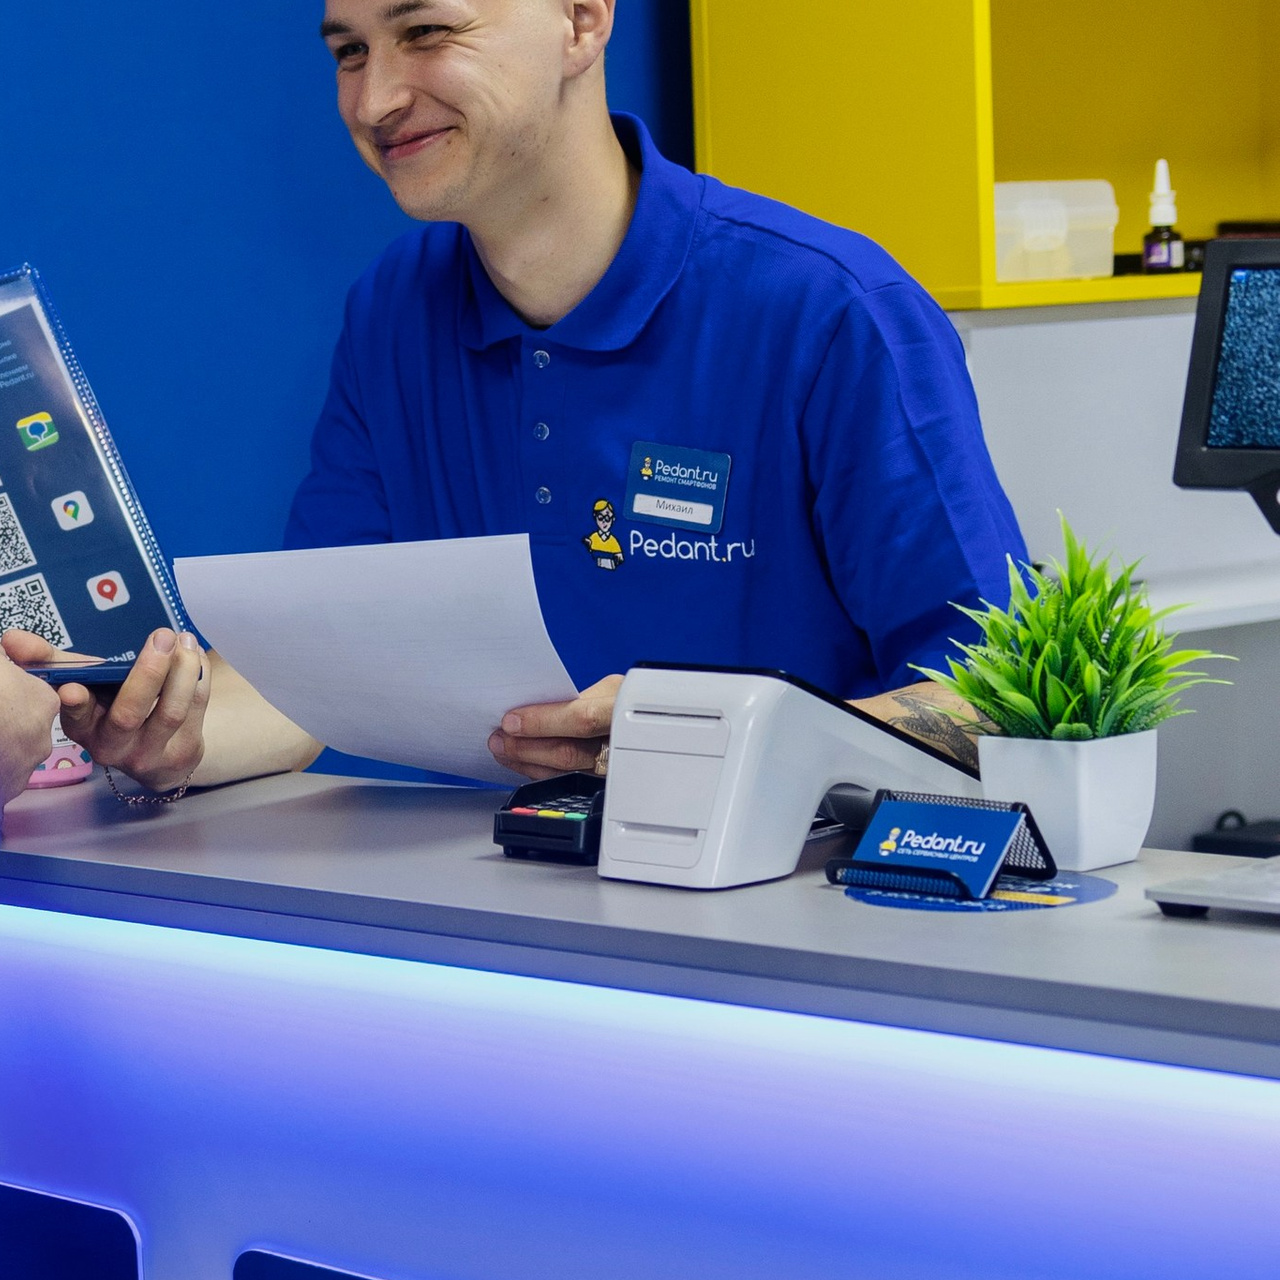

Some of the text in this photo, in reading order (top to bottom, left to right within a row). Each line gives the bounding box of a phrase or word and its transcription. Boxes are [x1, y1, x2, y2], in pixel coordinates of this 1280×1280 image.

[654, 474, 717, 490] РЕМОНТ СМАРТФОНОВ
[655, 459, 718, 483] Pedant.ru
[655, 499, 694, 514] Михаил
[629, 529, 756, 563] Pedant.ru
[900, 829, 986, 855] Pedant.ru
